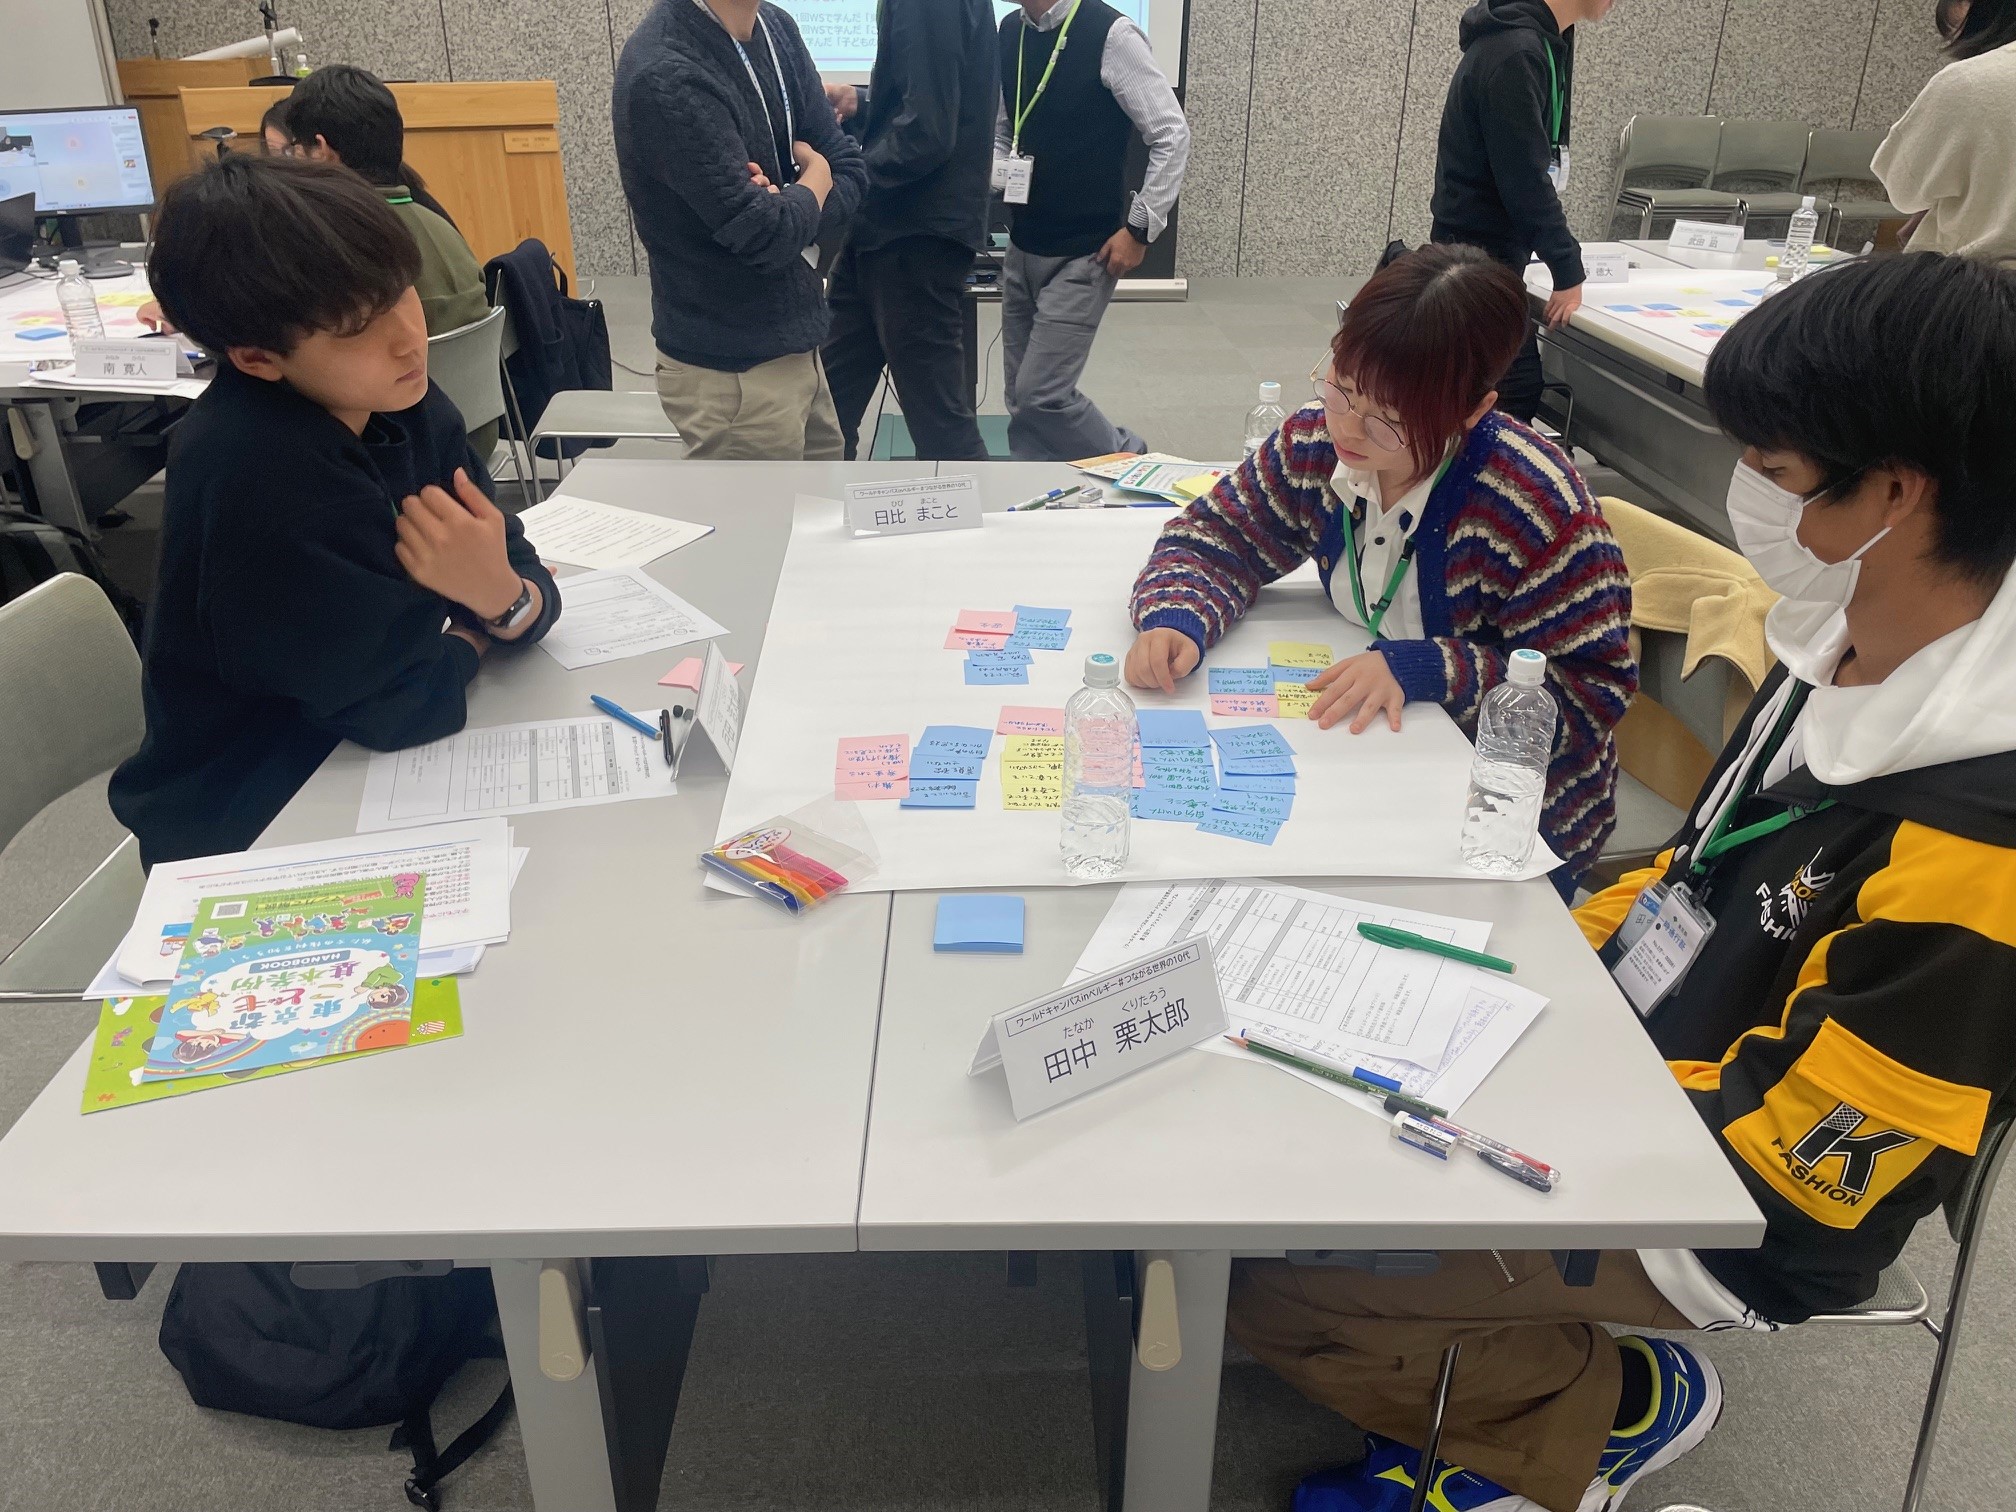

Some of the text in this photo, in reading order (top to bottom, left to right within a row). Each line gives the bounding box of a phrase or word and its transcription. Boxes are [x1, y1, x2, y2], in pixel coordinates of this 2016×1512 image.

[875, 504, 958, 526] 日比 まこと
[230, 960, 361, 991] 基本条例
[259, 951, 342, 971] HANDBOOK
[1016, 952, 1192, 1028] ワールドキャンパスinベルギー#つながる世界の10代
[228, 997, 347, 1030] 東京都
[1063, 986, 1167, 1040] たなか くりたろう
[1043, 997, 1190, 1084] 田中 栗太郎
[1415, 1120, 1445, 1138] MONO
[1791, 1101, 1918, 1196] K
[1769, 1136, 1864, 1208] FASHION
